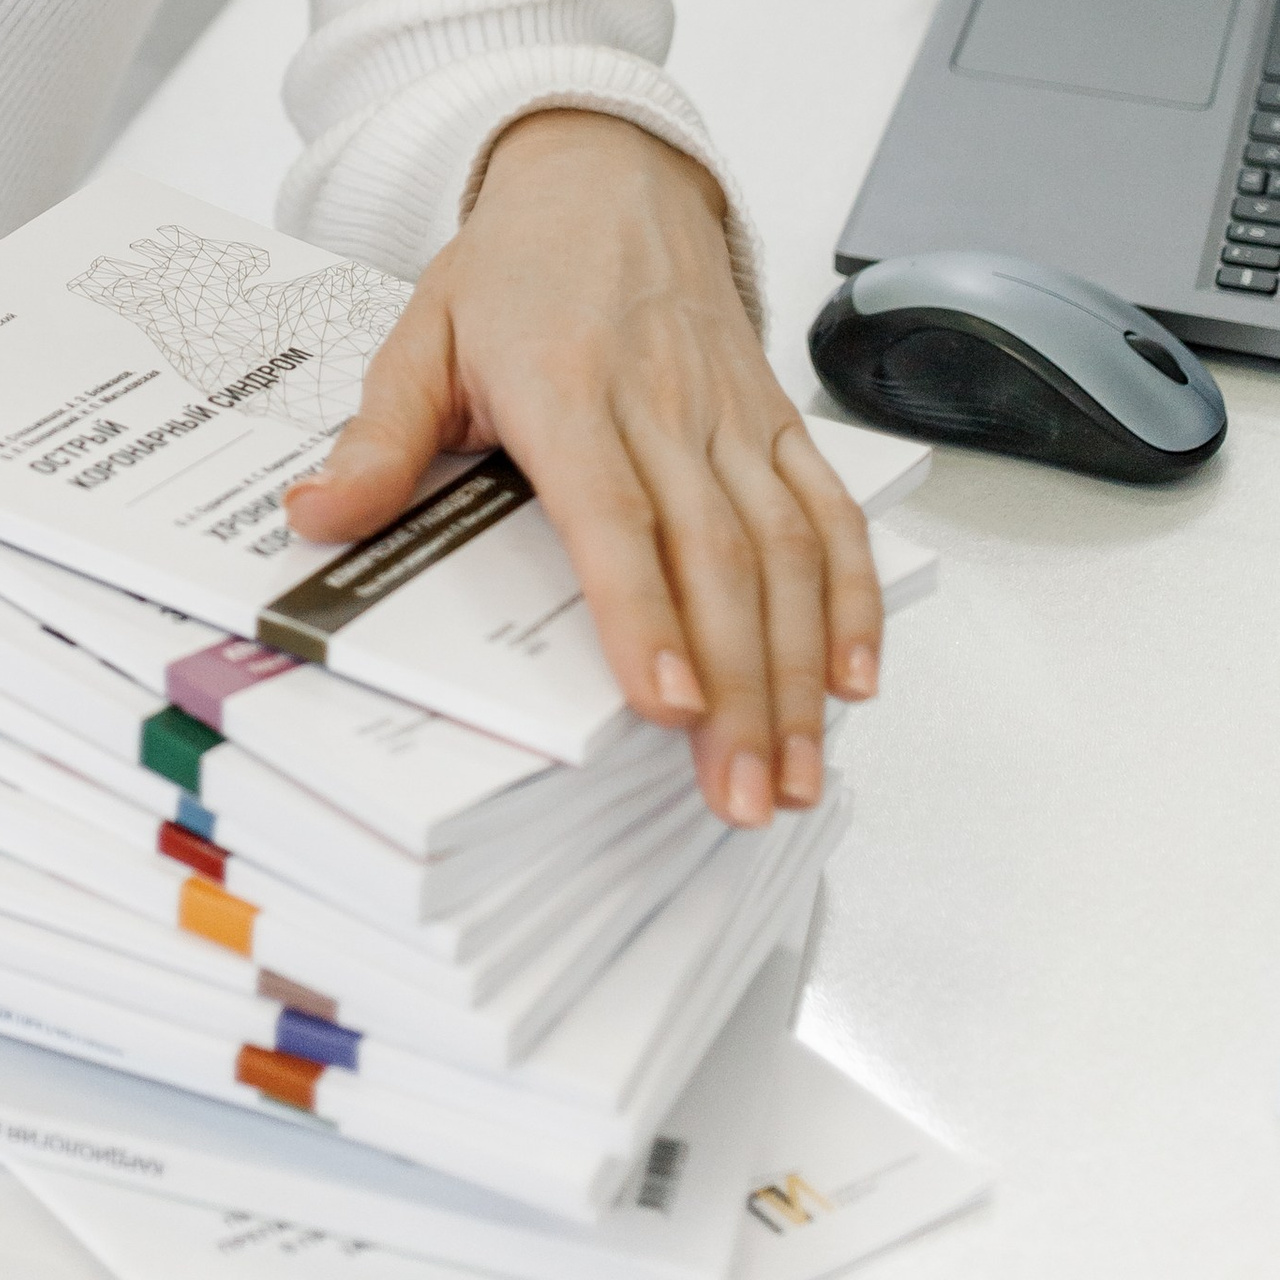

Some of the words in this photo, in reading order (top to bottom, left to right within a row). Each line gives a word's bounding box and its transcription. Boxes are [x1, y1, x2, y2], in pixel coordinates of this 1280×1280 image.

[28, 418, 130, 475] ОСТРЫЙ
[67, 403, 221, 490] КОРОНАРНЫЙ
[208, 346, 314, 409] СИНДРОМ
[7, 1124, 166, 1176] КАРДИОЛОГИЯ
